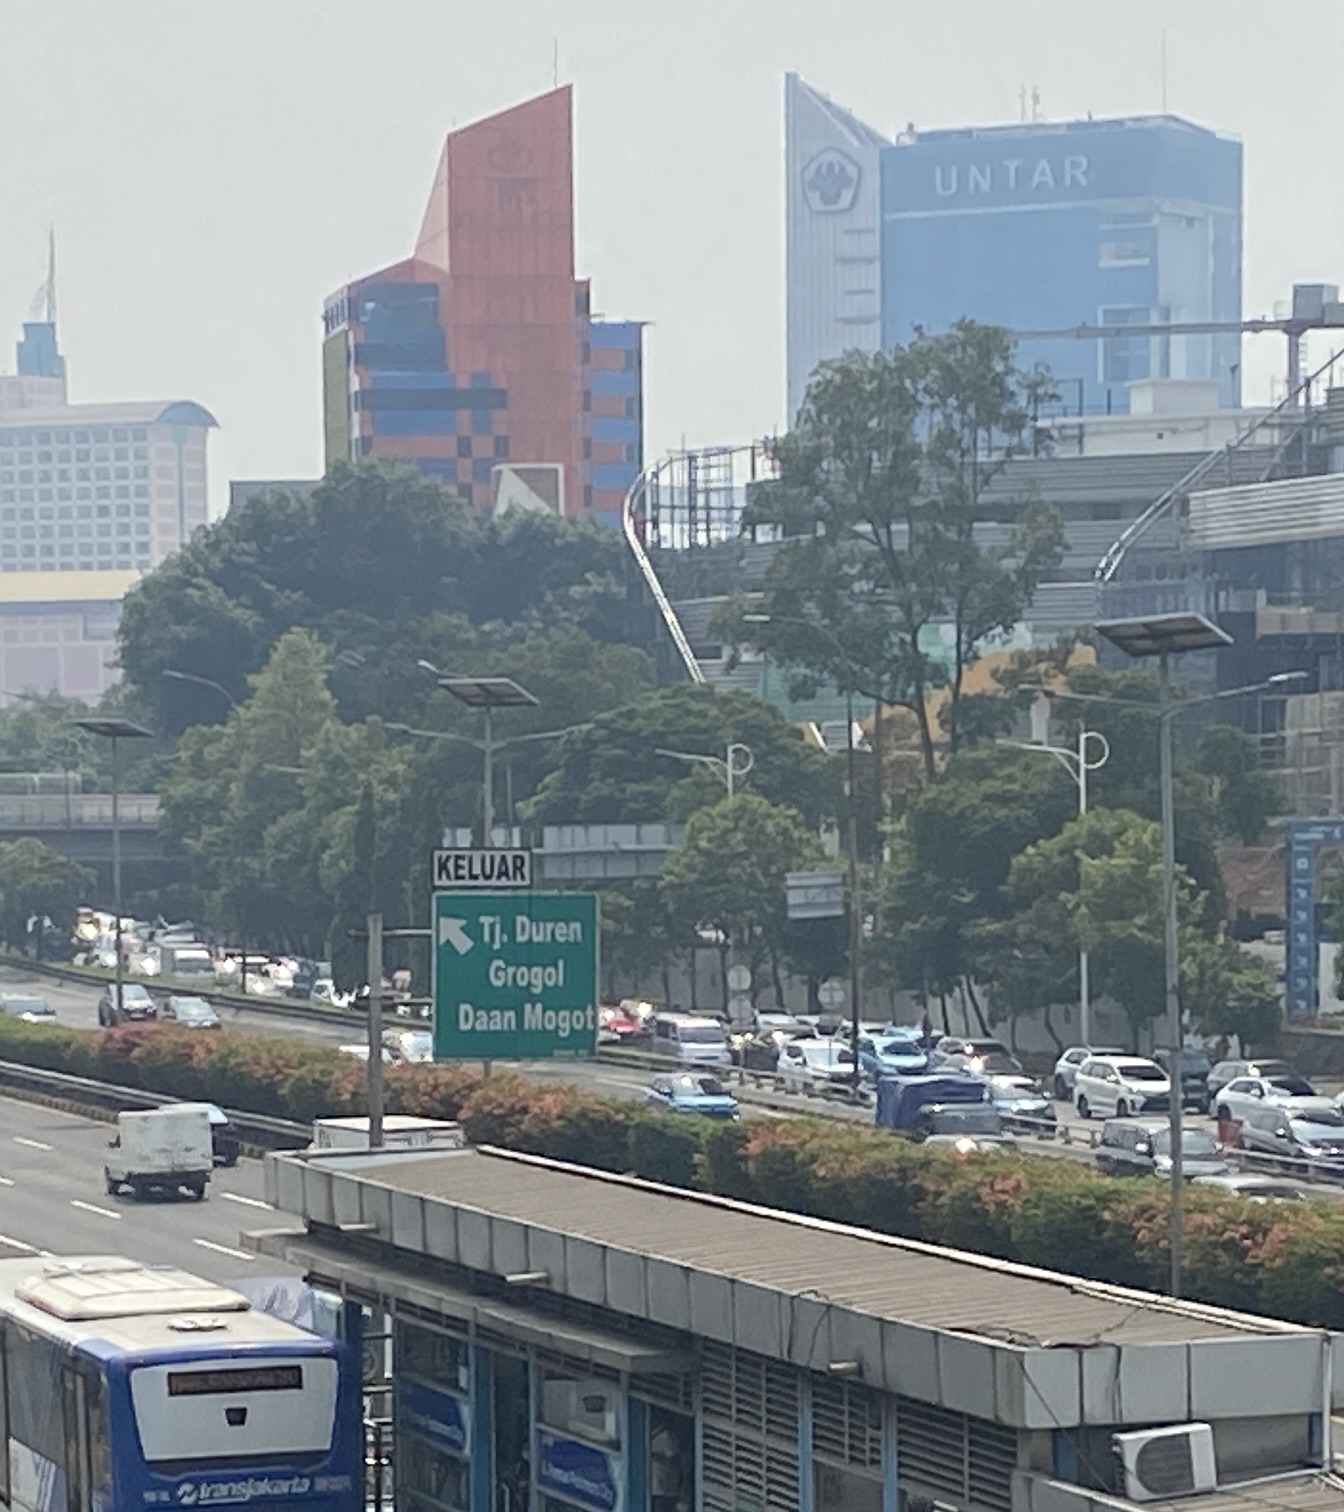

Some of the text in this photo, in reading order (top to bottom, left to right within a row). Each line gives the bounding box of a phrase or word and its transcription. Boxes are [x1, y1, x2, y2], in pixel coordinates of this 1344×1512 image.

[934, 154, 1089, 197] UNTAR
[437, 853, 526, 881] KELUAR
[478, 914, 582, 950] Tj. Duren
[489, 958, 564, 994] Grogol
[458, 1002, 594, 1038] Daan Mogot
[198, 1477, 312, 1504] transjakarta
